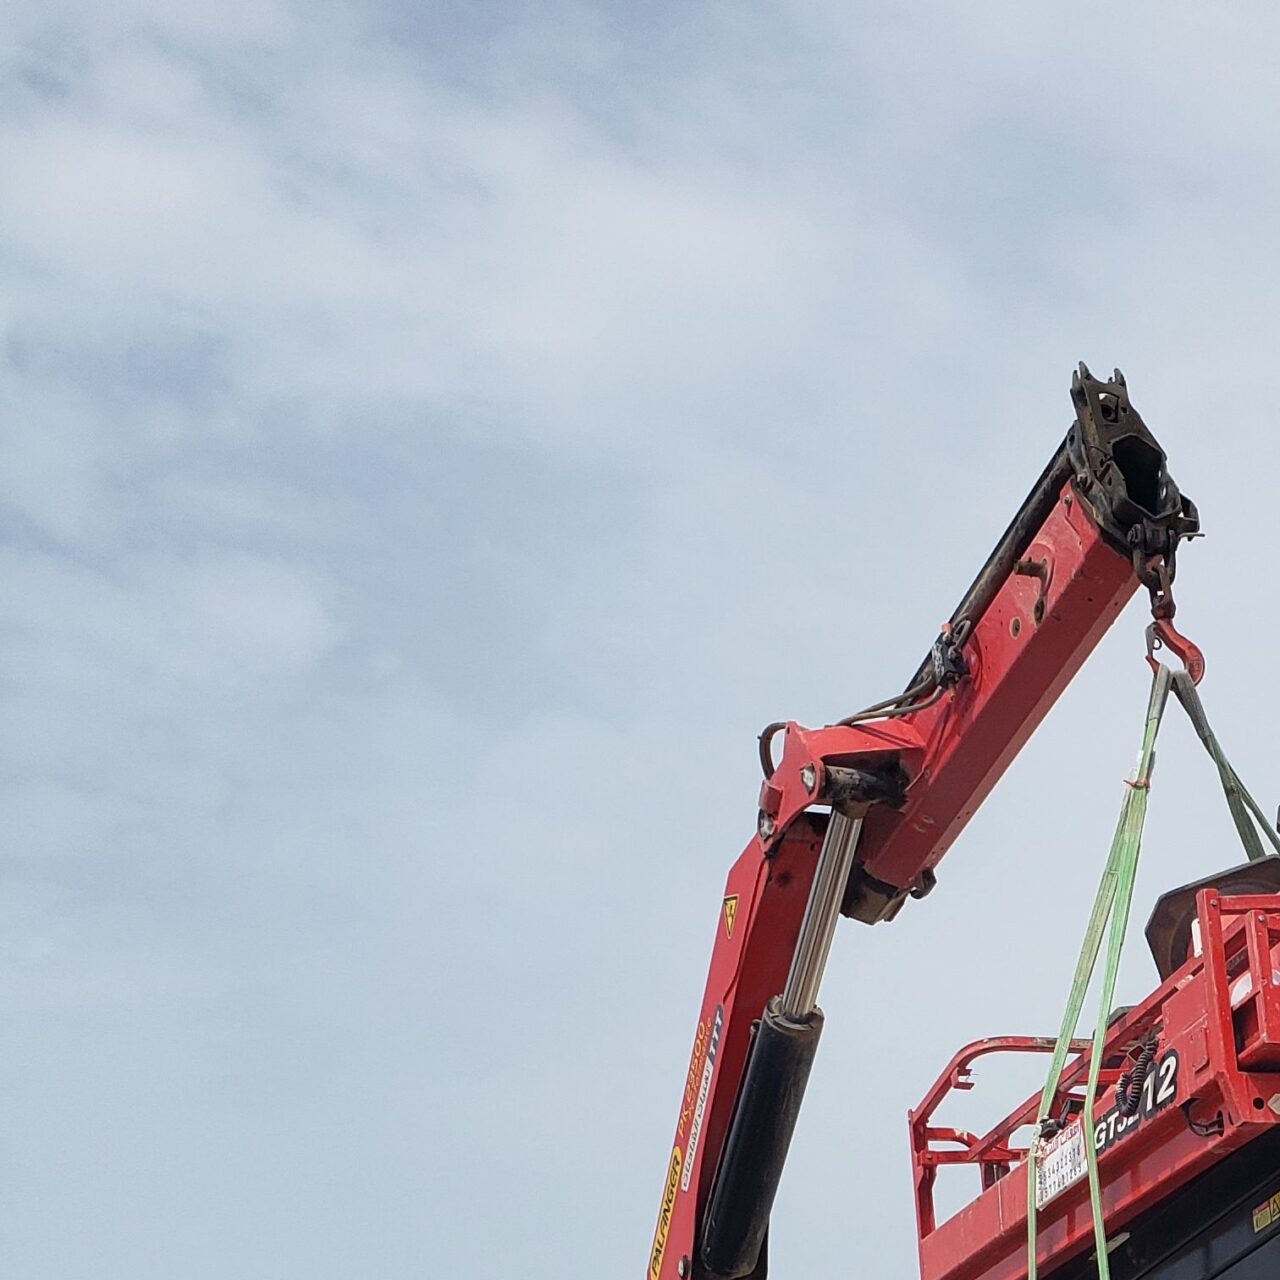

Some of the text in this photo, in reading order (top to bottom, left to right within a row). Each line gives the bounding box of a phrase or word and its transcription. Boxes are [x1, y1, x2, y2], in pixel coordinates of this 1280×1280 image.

[679, 1103, 689, 1138] PK
[1094, 1056, 1177, 1150] GTJ 12
[652, 1155, 680, 1277] PALFINGER
